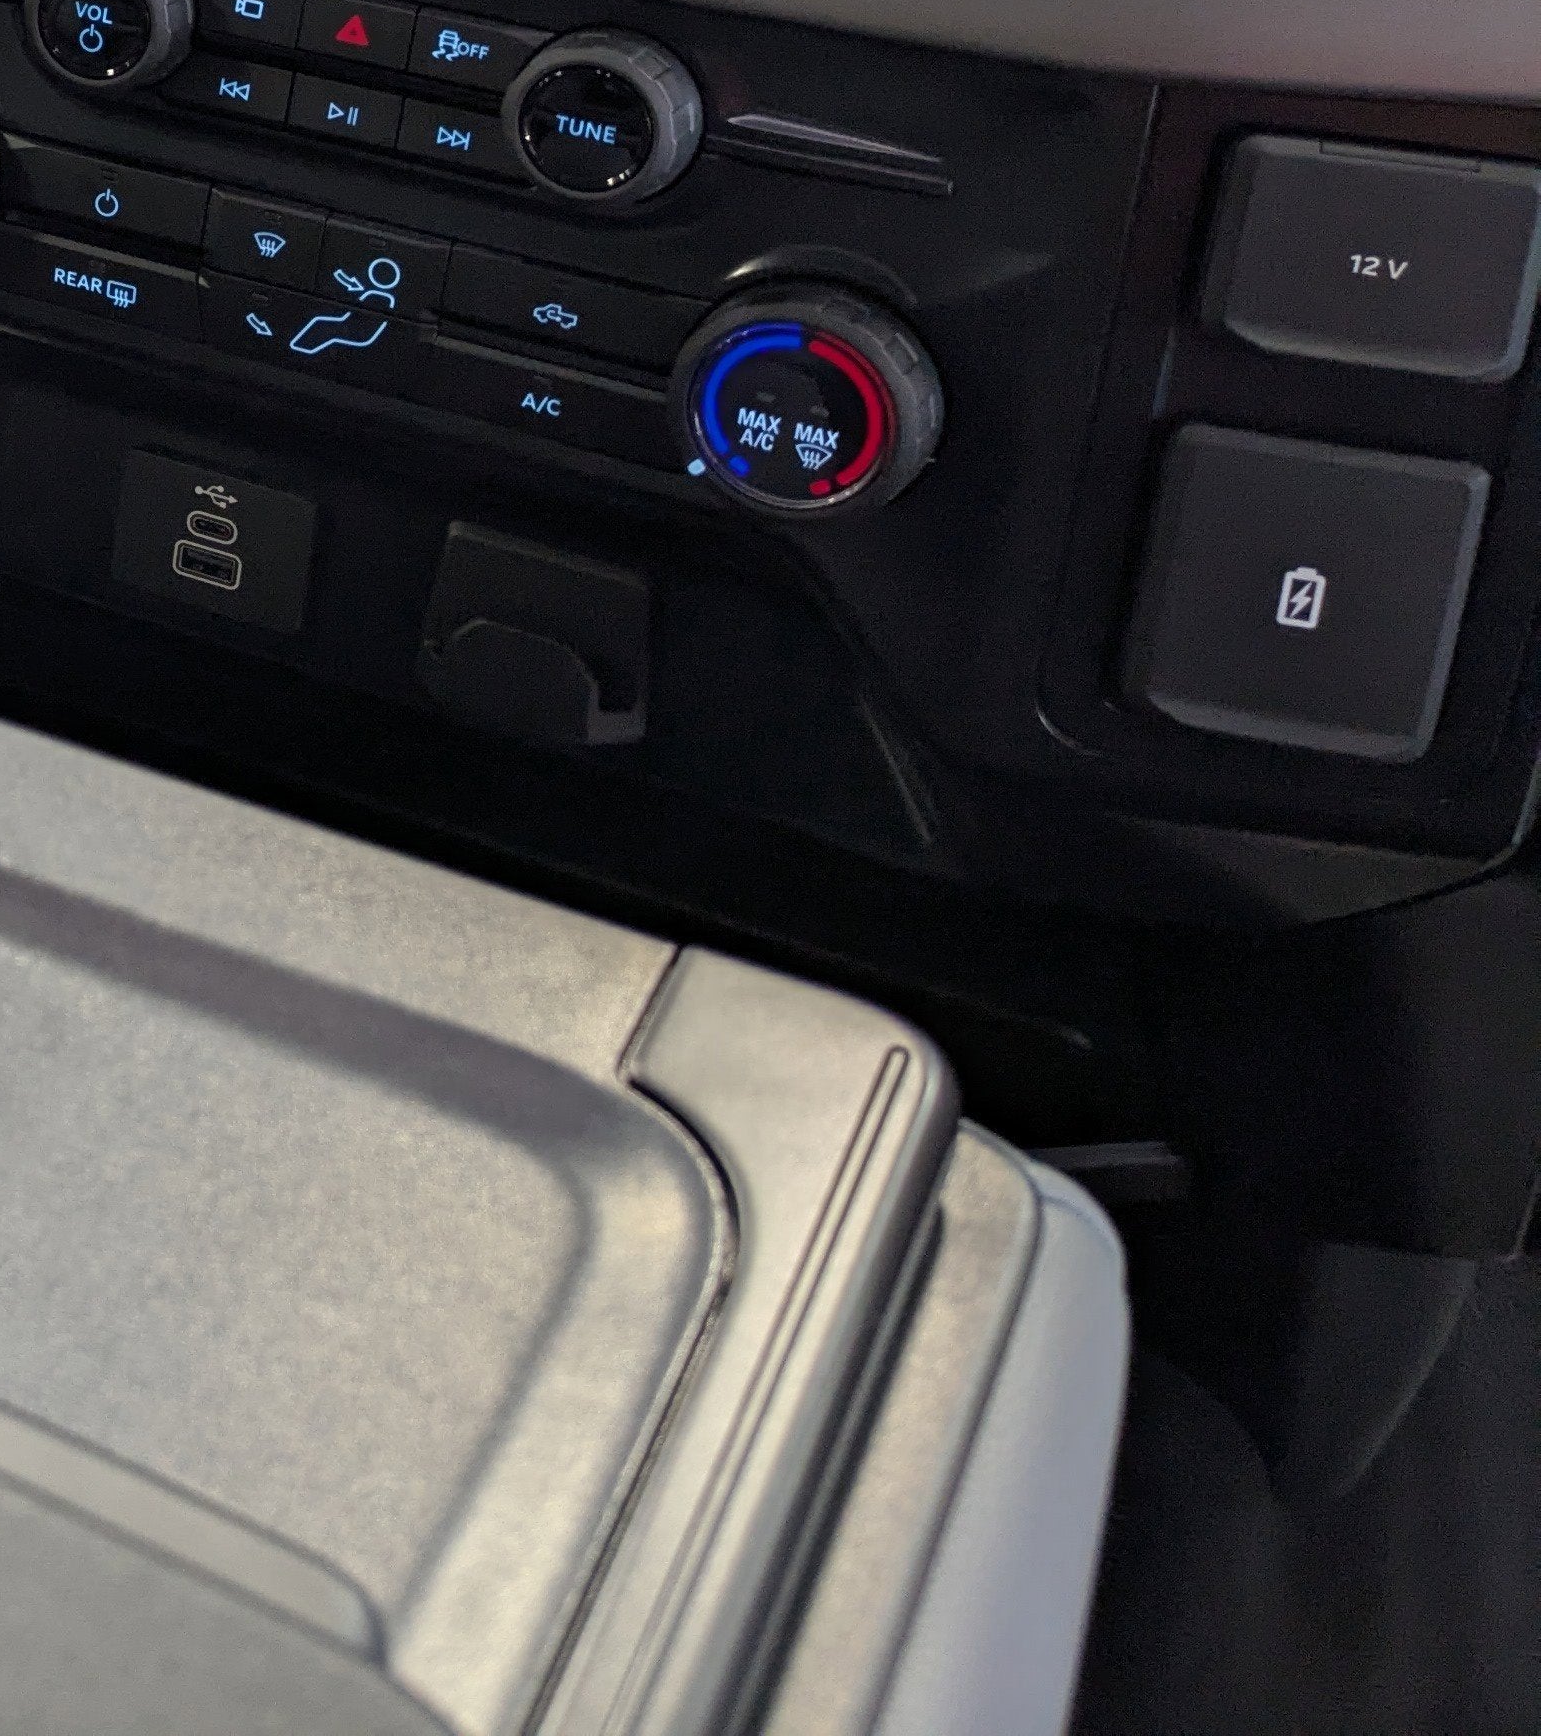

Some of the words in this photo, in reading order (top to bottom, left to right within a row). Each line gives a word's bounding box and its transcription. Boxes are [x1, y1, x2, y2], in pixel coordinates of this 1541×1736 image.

[75, 1, 113, 25] VOL
[457, 40, 490, 60] OFF
[555, 114, 617, 145] TUNE
[53, 267, 103, 295] REAR
[1350, 254, 1380, 276] 12
[1388, 258, 1408, 281] V
[520, 391, 561, 417] A/C
[737, 408, 781, 435] MAX
[739, 427, 775, 452] A/C
[794, 422, 839, 450] MAX
